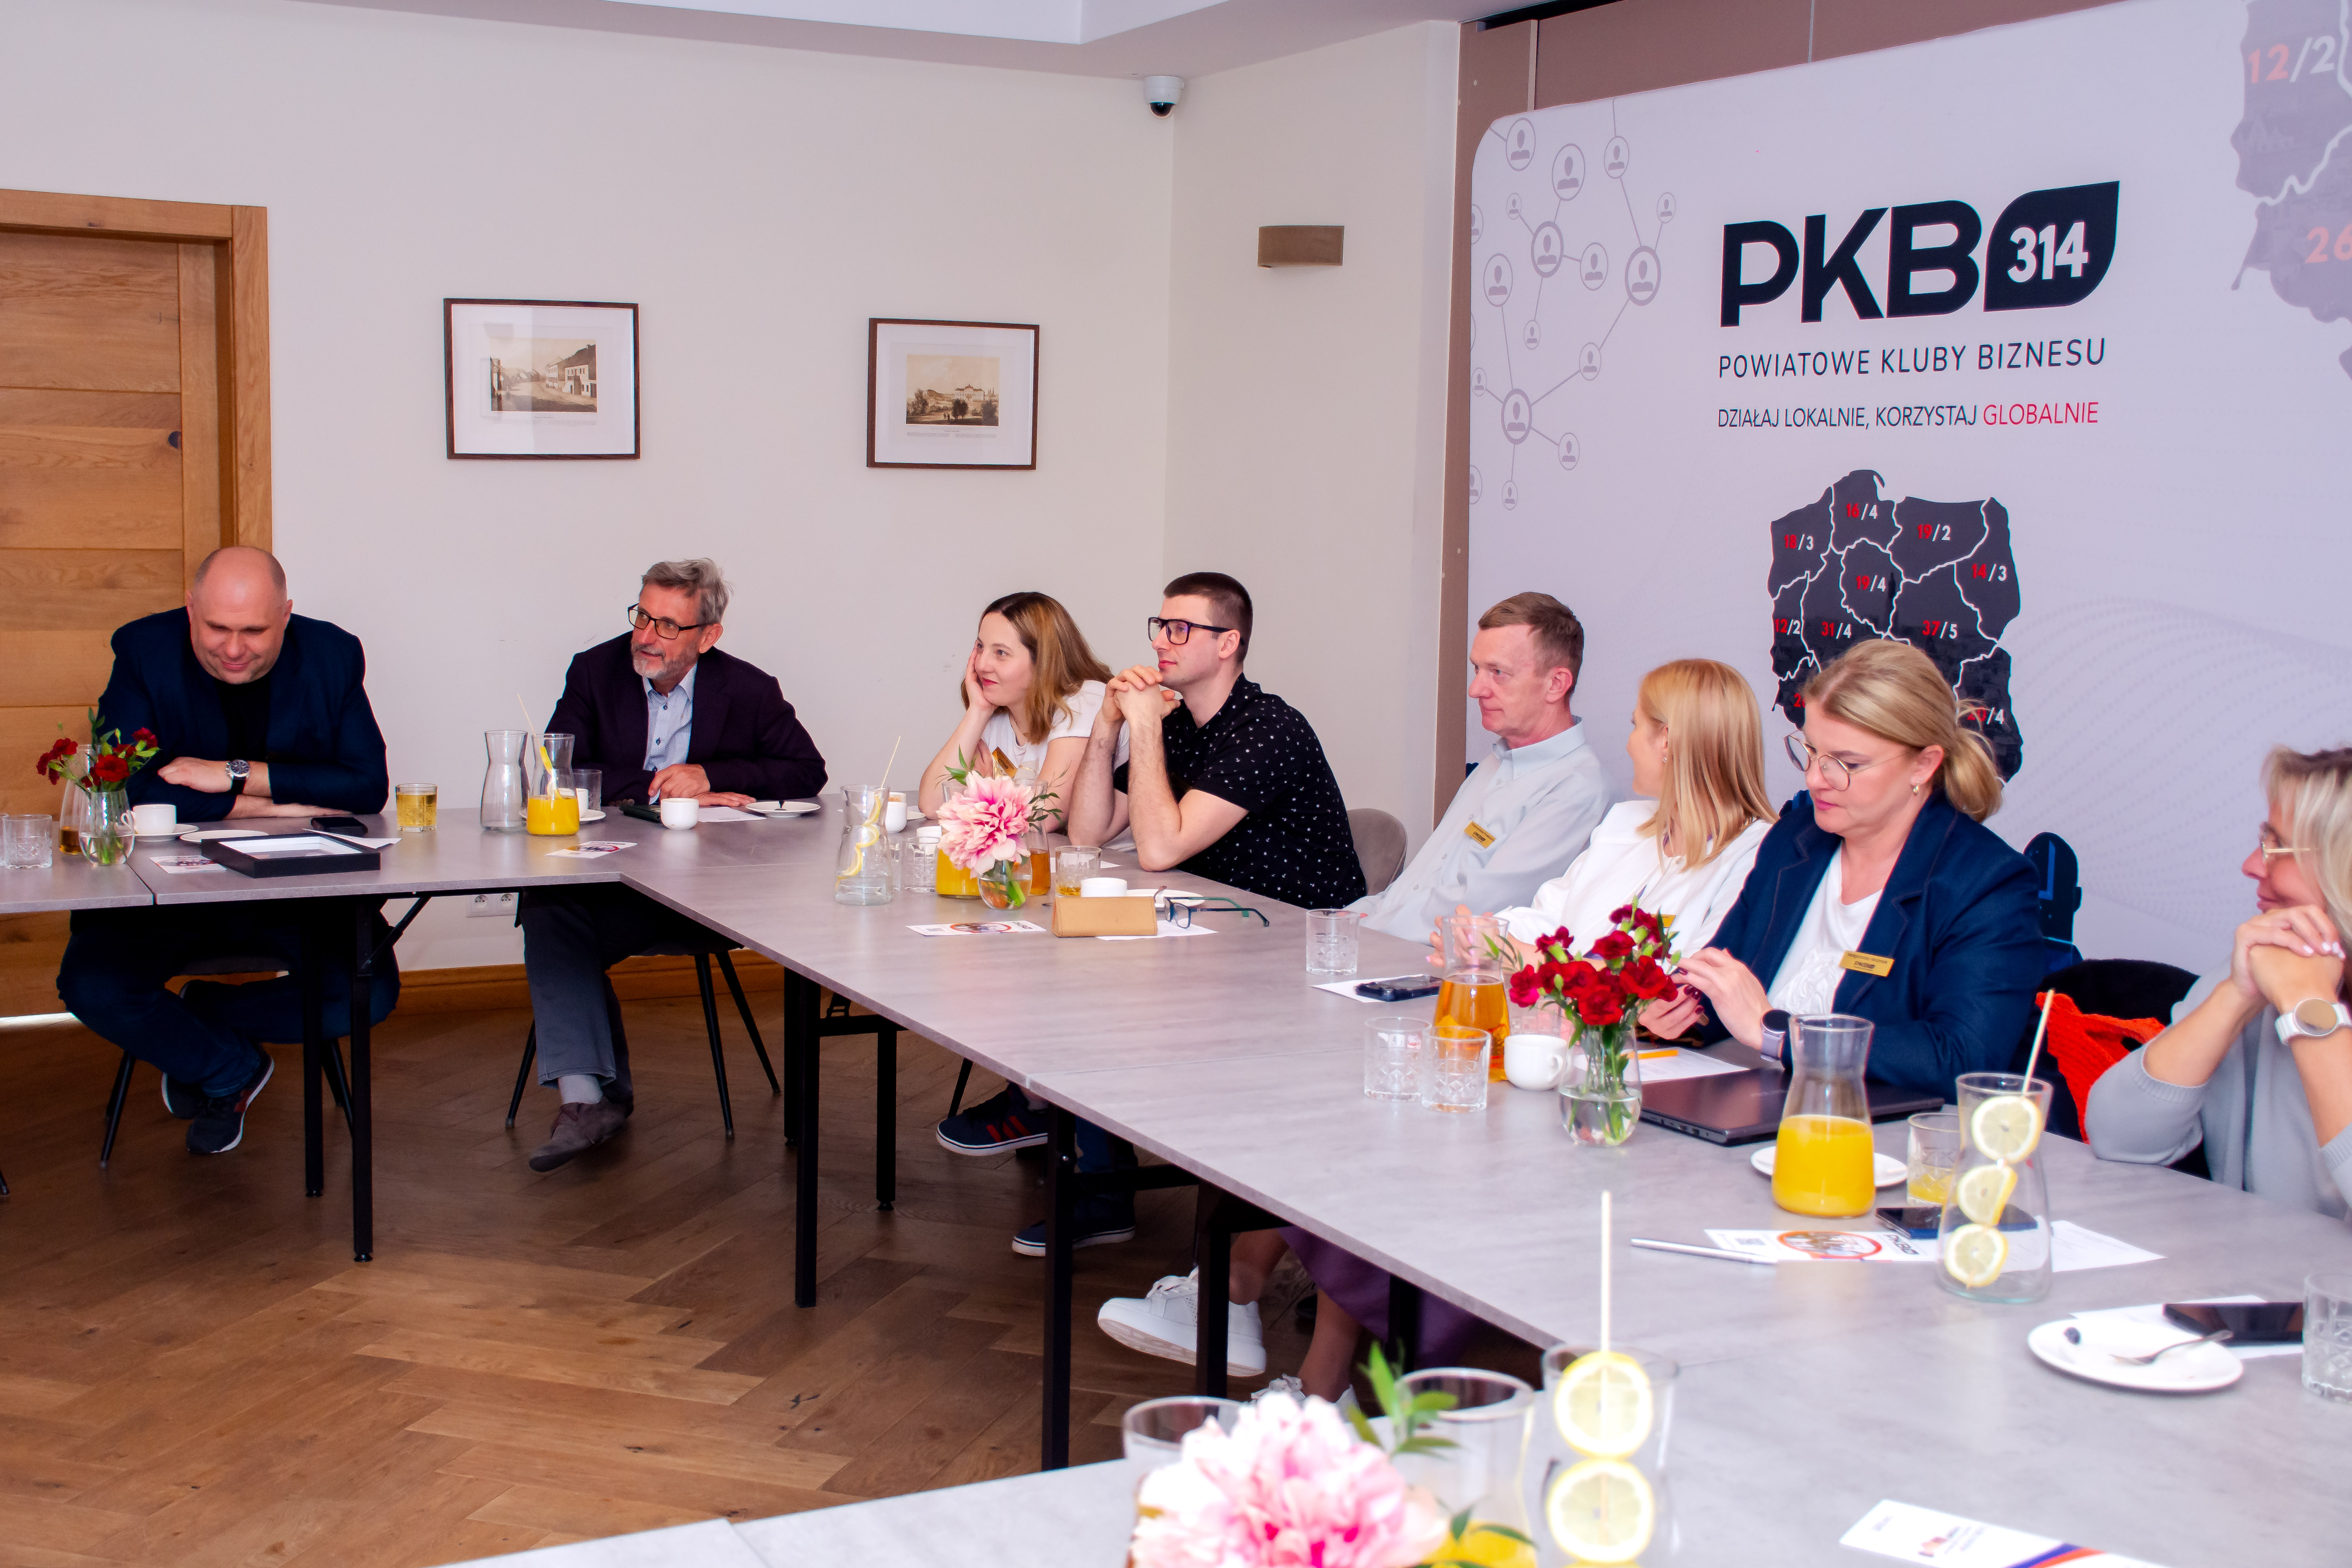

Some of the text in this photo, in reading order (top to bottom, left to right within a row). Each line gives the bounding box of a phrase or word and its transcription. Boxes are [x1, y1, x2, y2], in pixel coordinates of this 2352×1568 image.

[2248, 35, 2336, 83] 12/2
[1720, 200, 2088, 327] PKB 314
[1719, 338, 2106, 378] POWIATOWE KLUBY BIZNESU
[1718, 402, 2099, 430] DZIAŁAJ LOKALNIE, KORZYSTAJ GLOBALNIE
[1846, 503, 1878, 520] 16/4
[1917, 524, 1951, 541] 19/2
[1784, 533, 1814, 551] 18/3
[1972, 563, 2007, 581] 14/3
[1856, 575, 1886, 592] 19/4
[1775, 618, 1801, 635] 12/2
[1821, 621, 1852, 639] 31/4
[1922, 620, 1958, 639] 37/5
